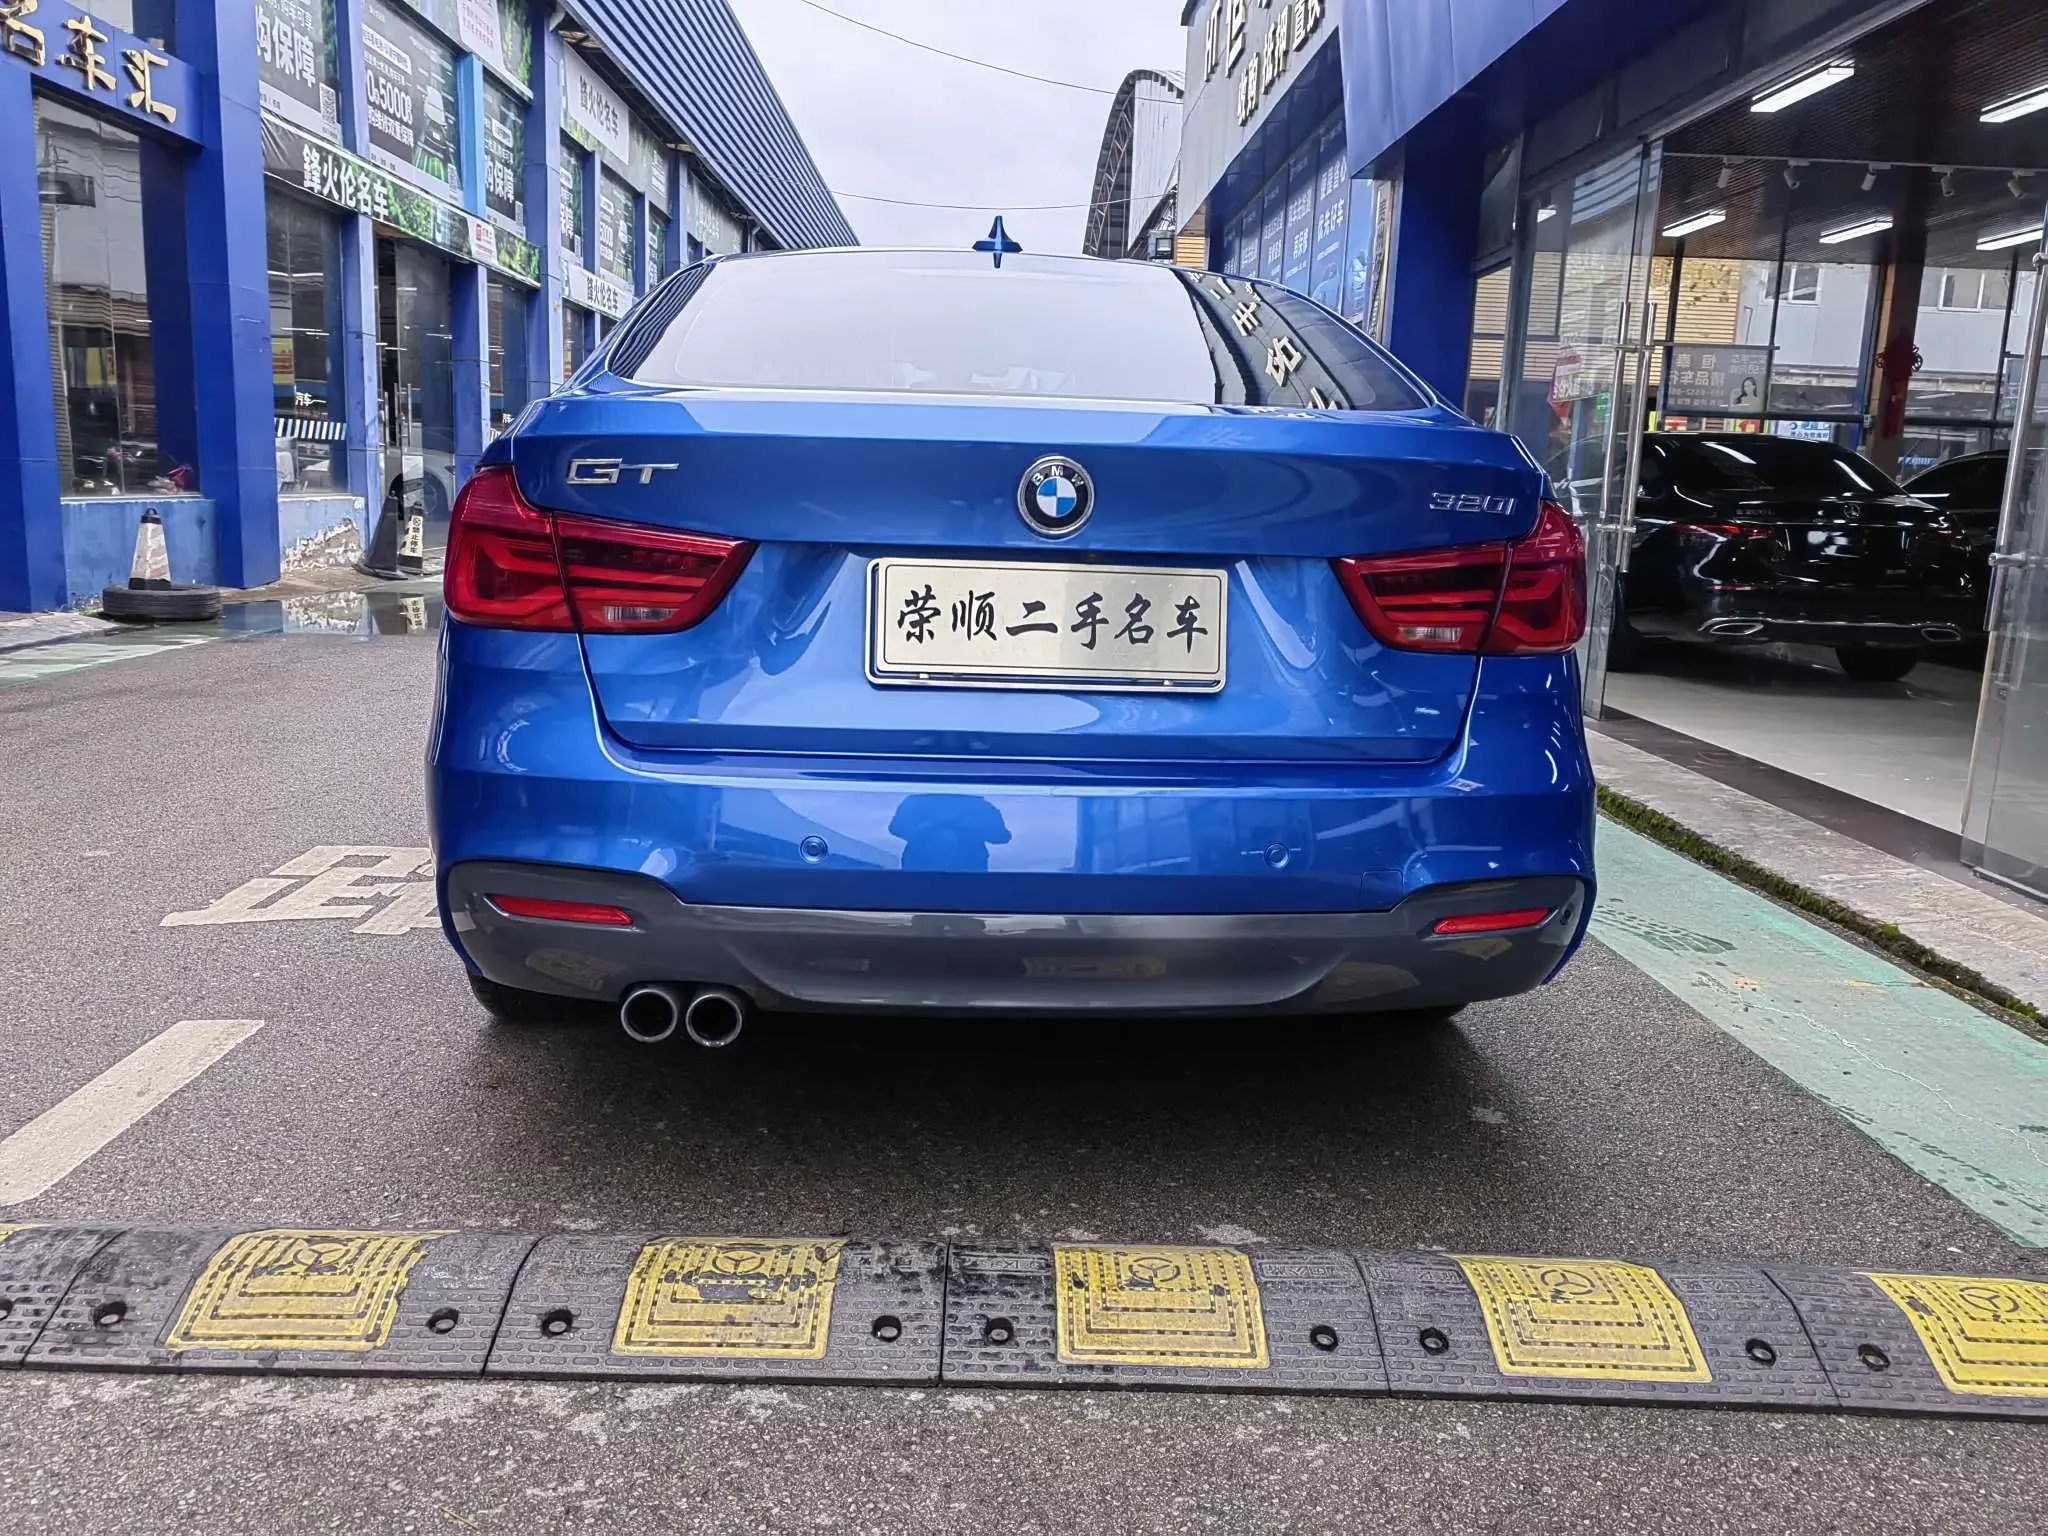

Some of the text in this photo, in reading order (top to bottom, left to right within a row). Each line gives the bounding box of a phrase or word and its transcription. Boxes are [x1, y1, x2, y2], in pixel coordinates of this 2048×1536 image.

[566, 457, 680, 484] GT
[1031, 465, 1085, 487] BMW
[897, 584, 1208, 653] 荣顺二手名车
